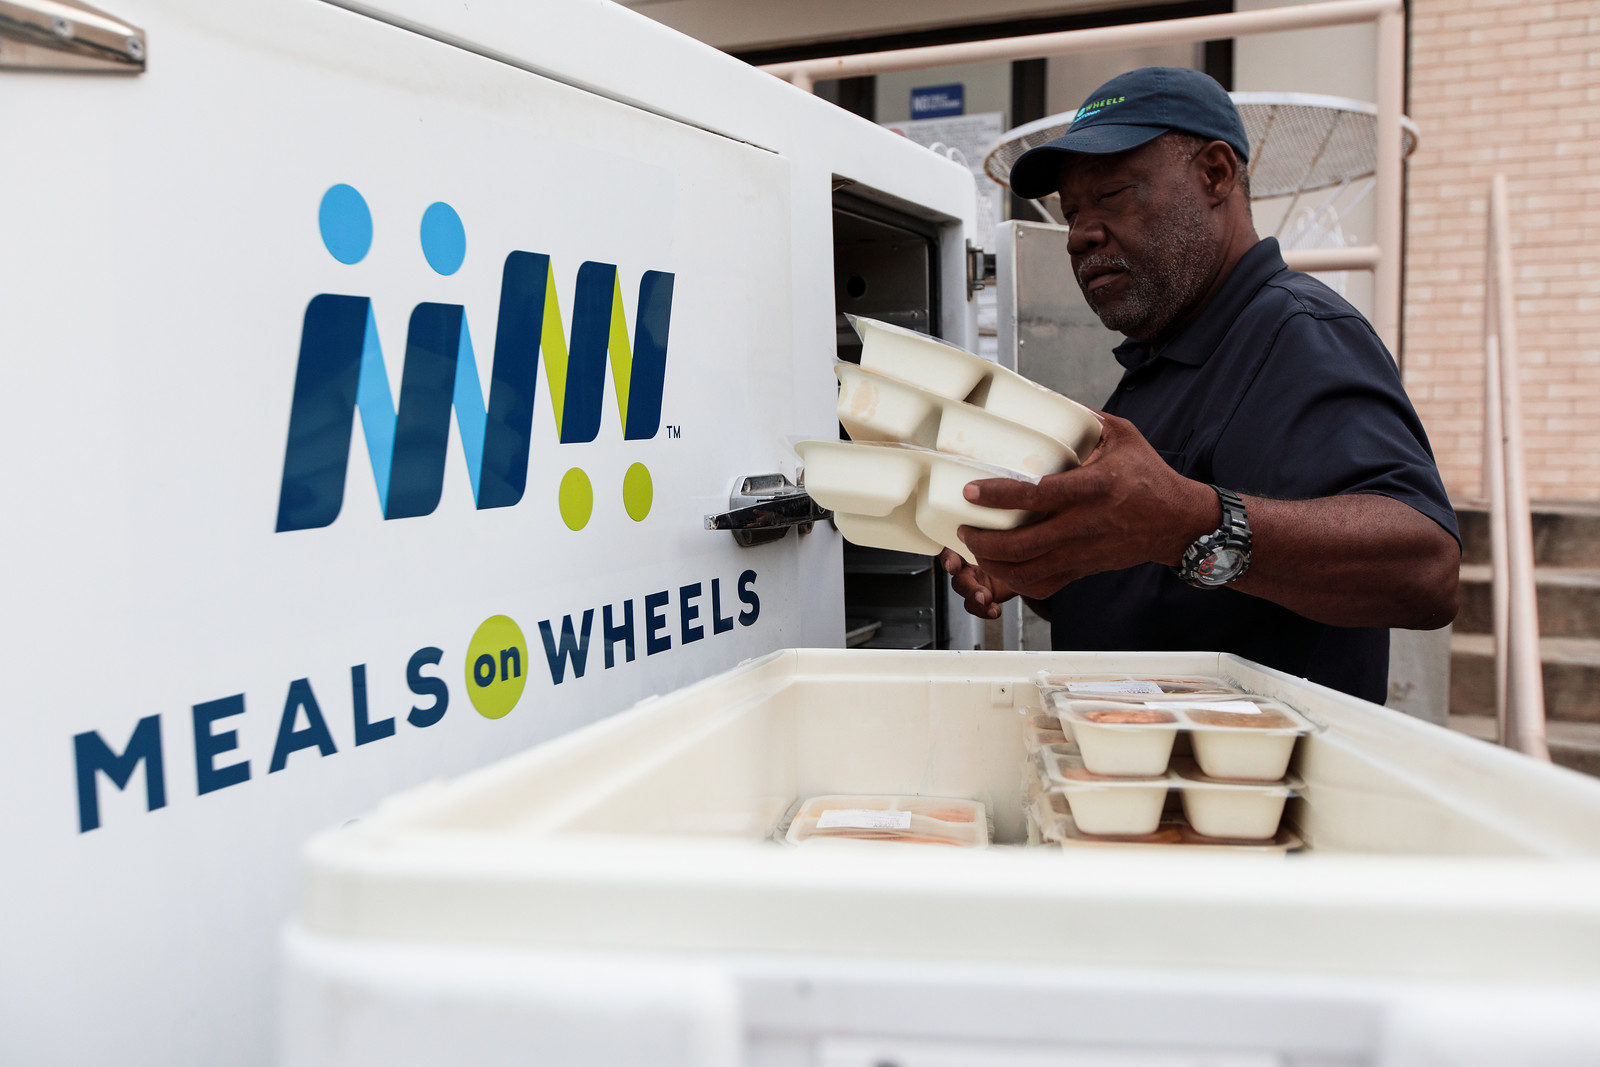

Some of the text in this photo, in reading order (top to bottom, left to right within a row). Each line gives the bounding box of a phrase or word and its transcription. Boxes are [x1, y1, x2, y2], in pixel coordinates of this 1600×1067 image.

[1085, 96, 1126, 111] WHEELS
[666, 425, 681, 439] TM
[73, 569, 761, 834] MEALS on WHEELS
